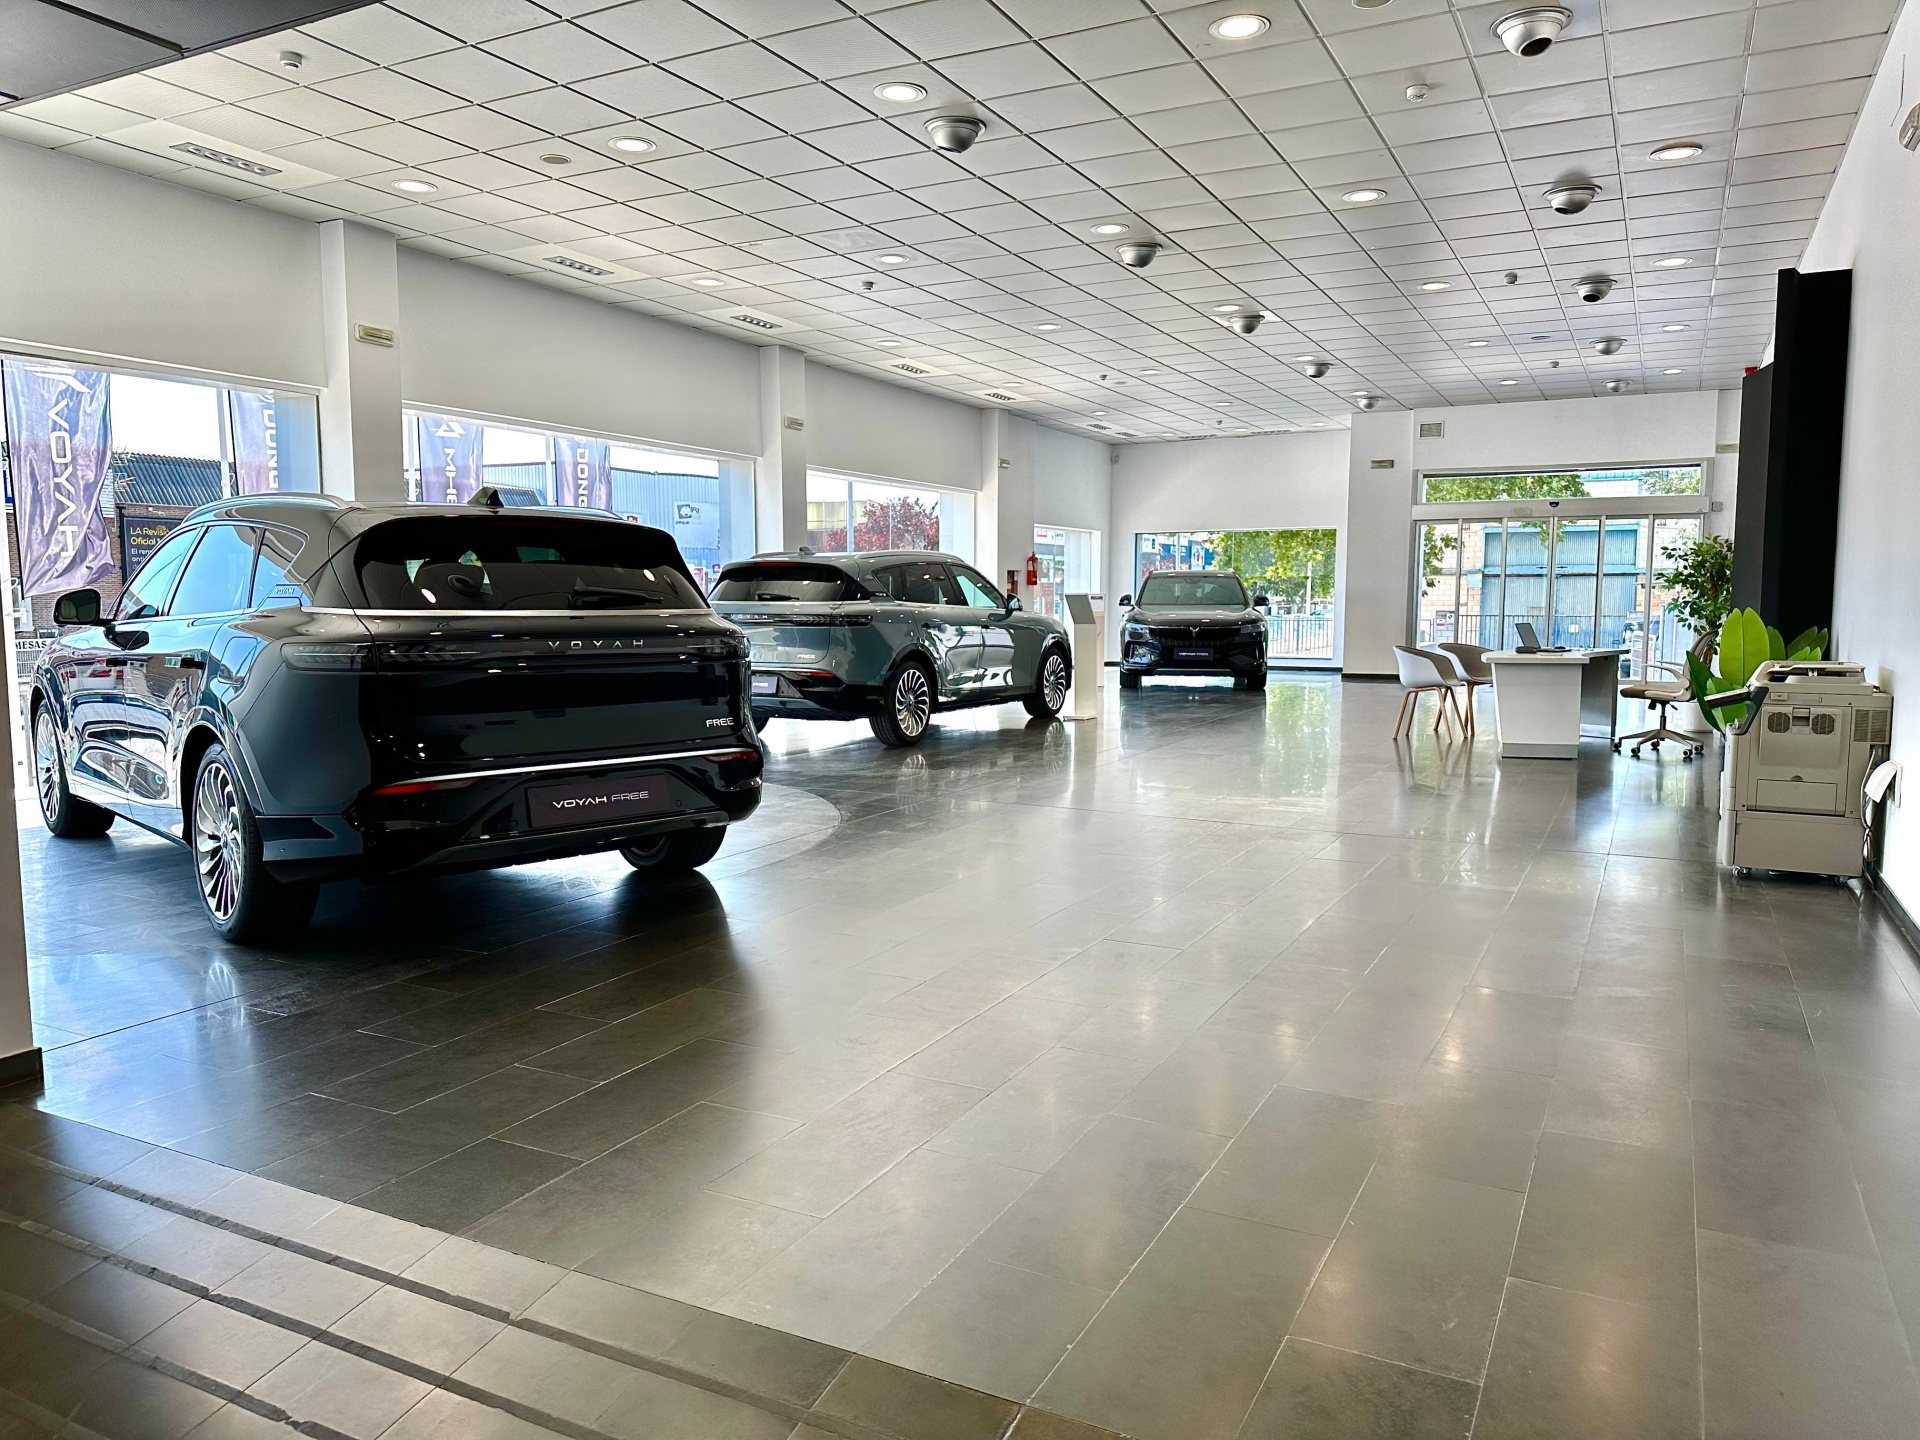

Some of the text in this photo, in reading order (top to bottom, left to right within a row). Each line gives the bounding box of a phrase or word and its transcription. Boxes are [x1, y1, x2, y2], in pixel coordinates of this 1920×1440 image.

[48, 398, 79, 557] VOYAH
[576, 448, 589, 508] DONG
[130, 526, 142, 535] LA
[130, 536, 156, 545] Oficial
[547, 639, 644, 650] VOYAH
[705, 717, 734, 728] FREE
[552, 790, 649, 810] VOYAH FREE
